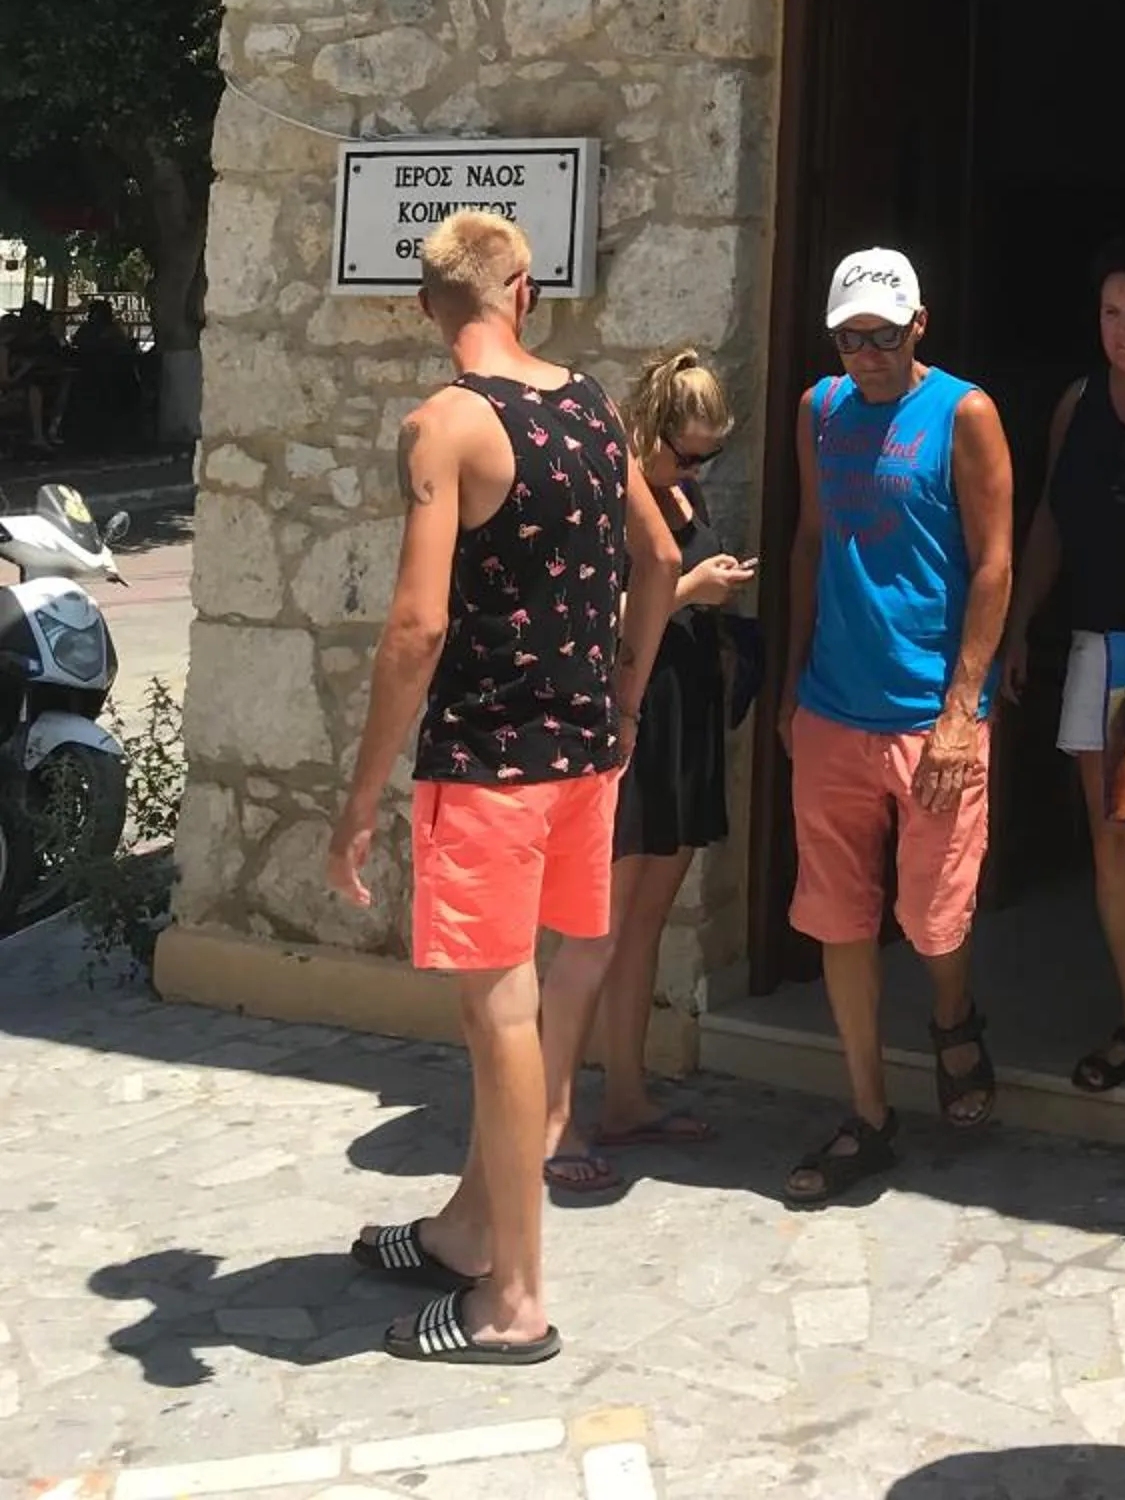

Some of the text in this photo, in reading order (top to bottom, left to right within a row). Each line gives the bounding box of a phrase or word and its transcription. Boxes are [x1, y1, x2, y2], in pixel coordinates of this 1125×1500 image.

[394, 165, 525, 188] ΙΕΡΟΣ ΝΑΟΣ
[397, 201, 517, 223] ΚΟΙΜΣ
[842, 265, 901, 289] Crete
